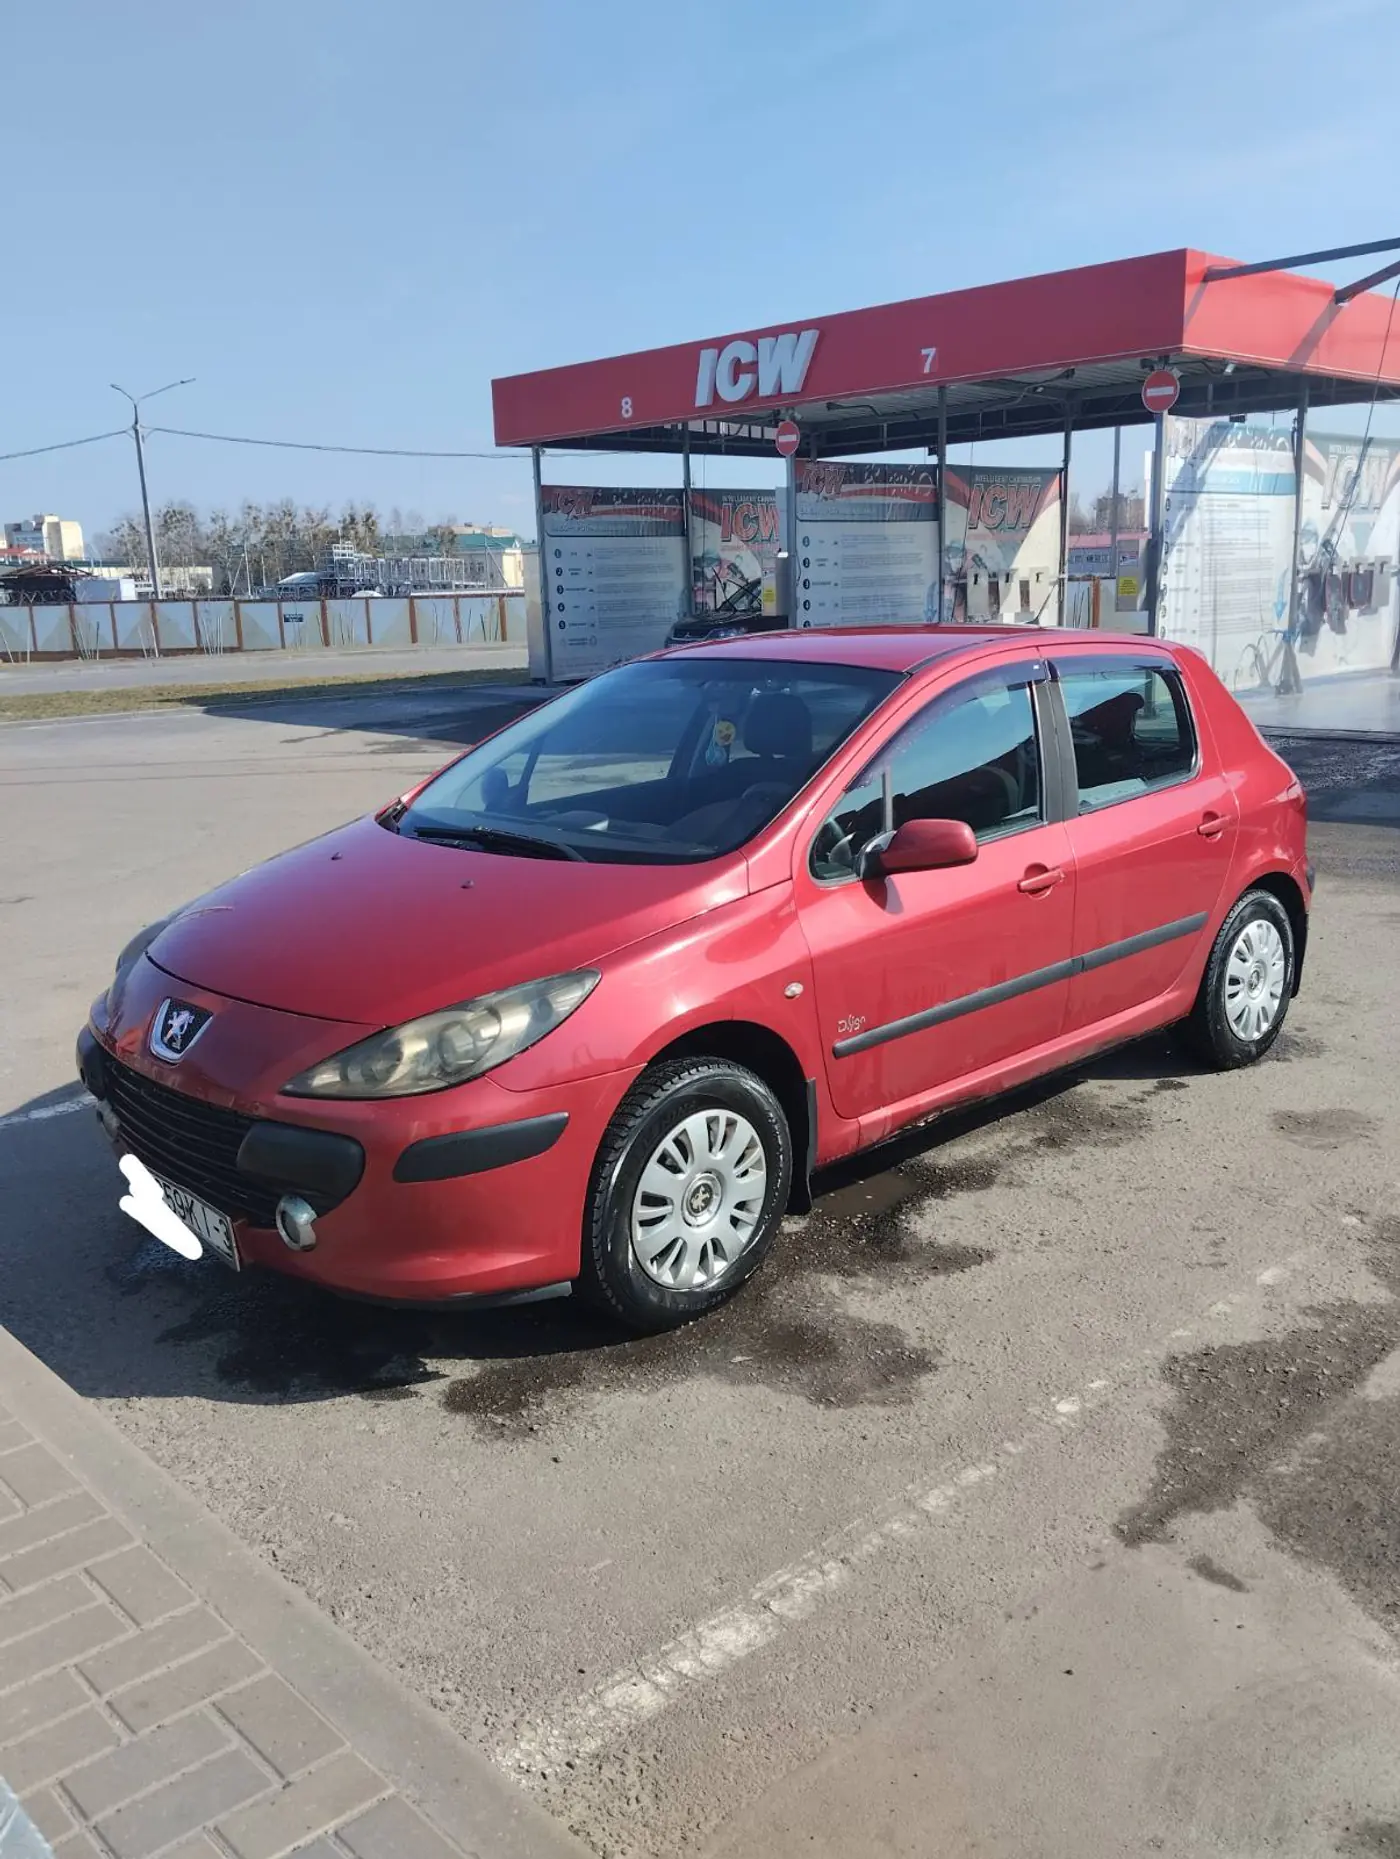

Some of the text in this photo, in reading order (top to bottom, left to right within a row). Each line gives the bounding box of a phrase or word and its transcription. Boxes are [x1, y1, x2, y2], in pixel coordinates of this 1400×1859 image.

[695, 329, 820, 408] ICW
[920, 347, 938, 374] 7
[620, 397, 633, 419] 8
[720, 502, 780, 543] ICW
[968, 483, 1042, 530] ICW
